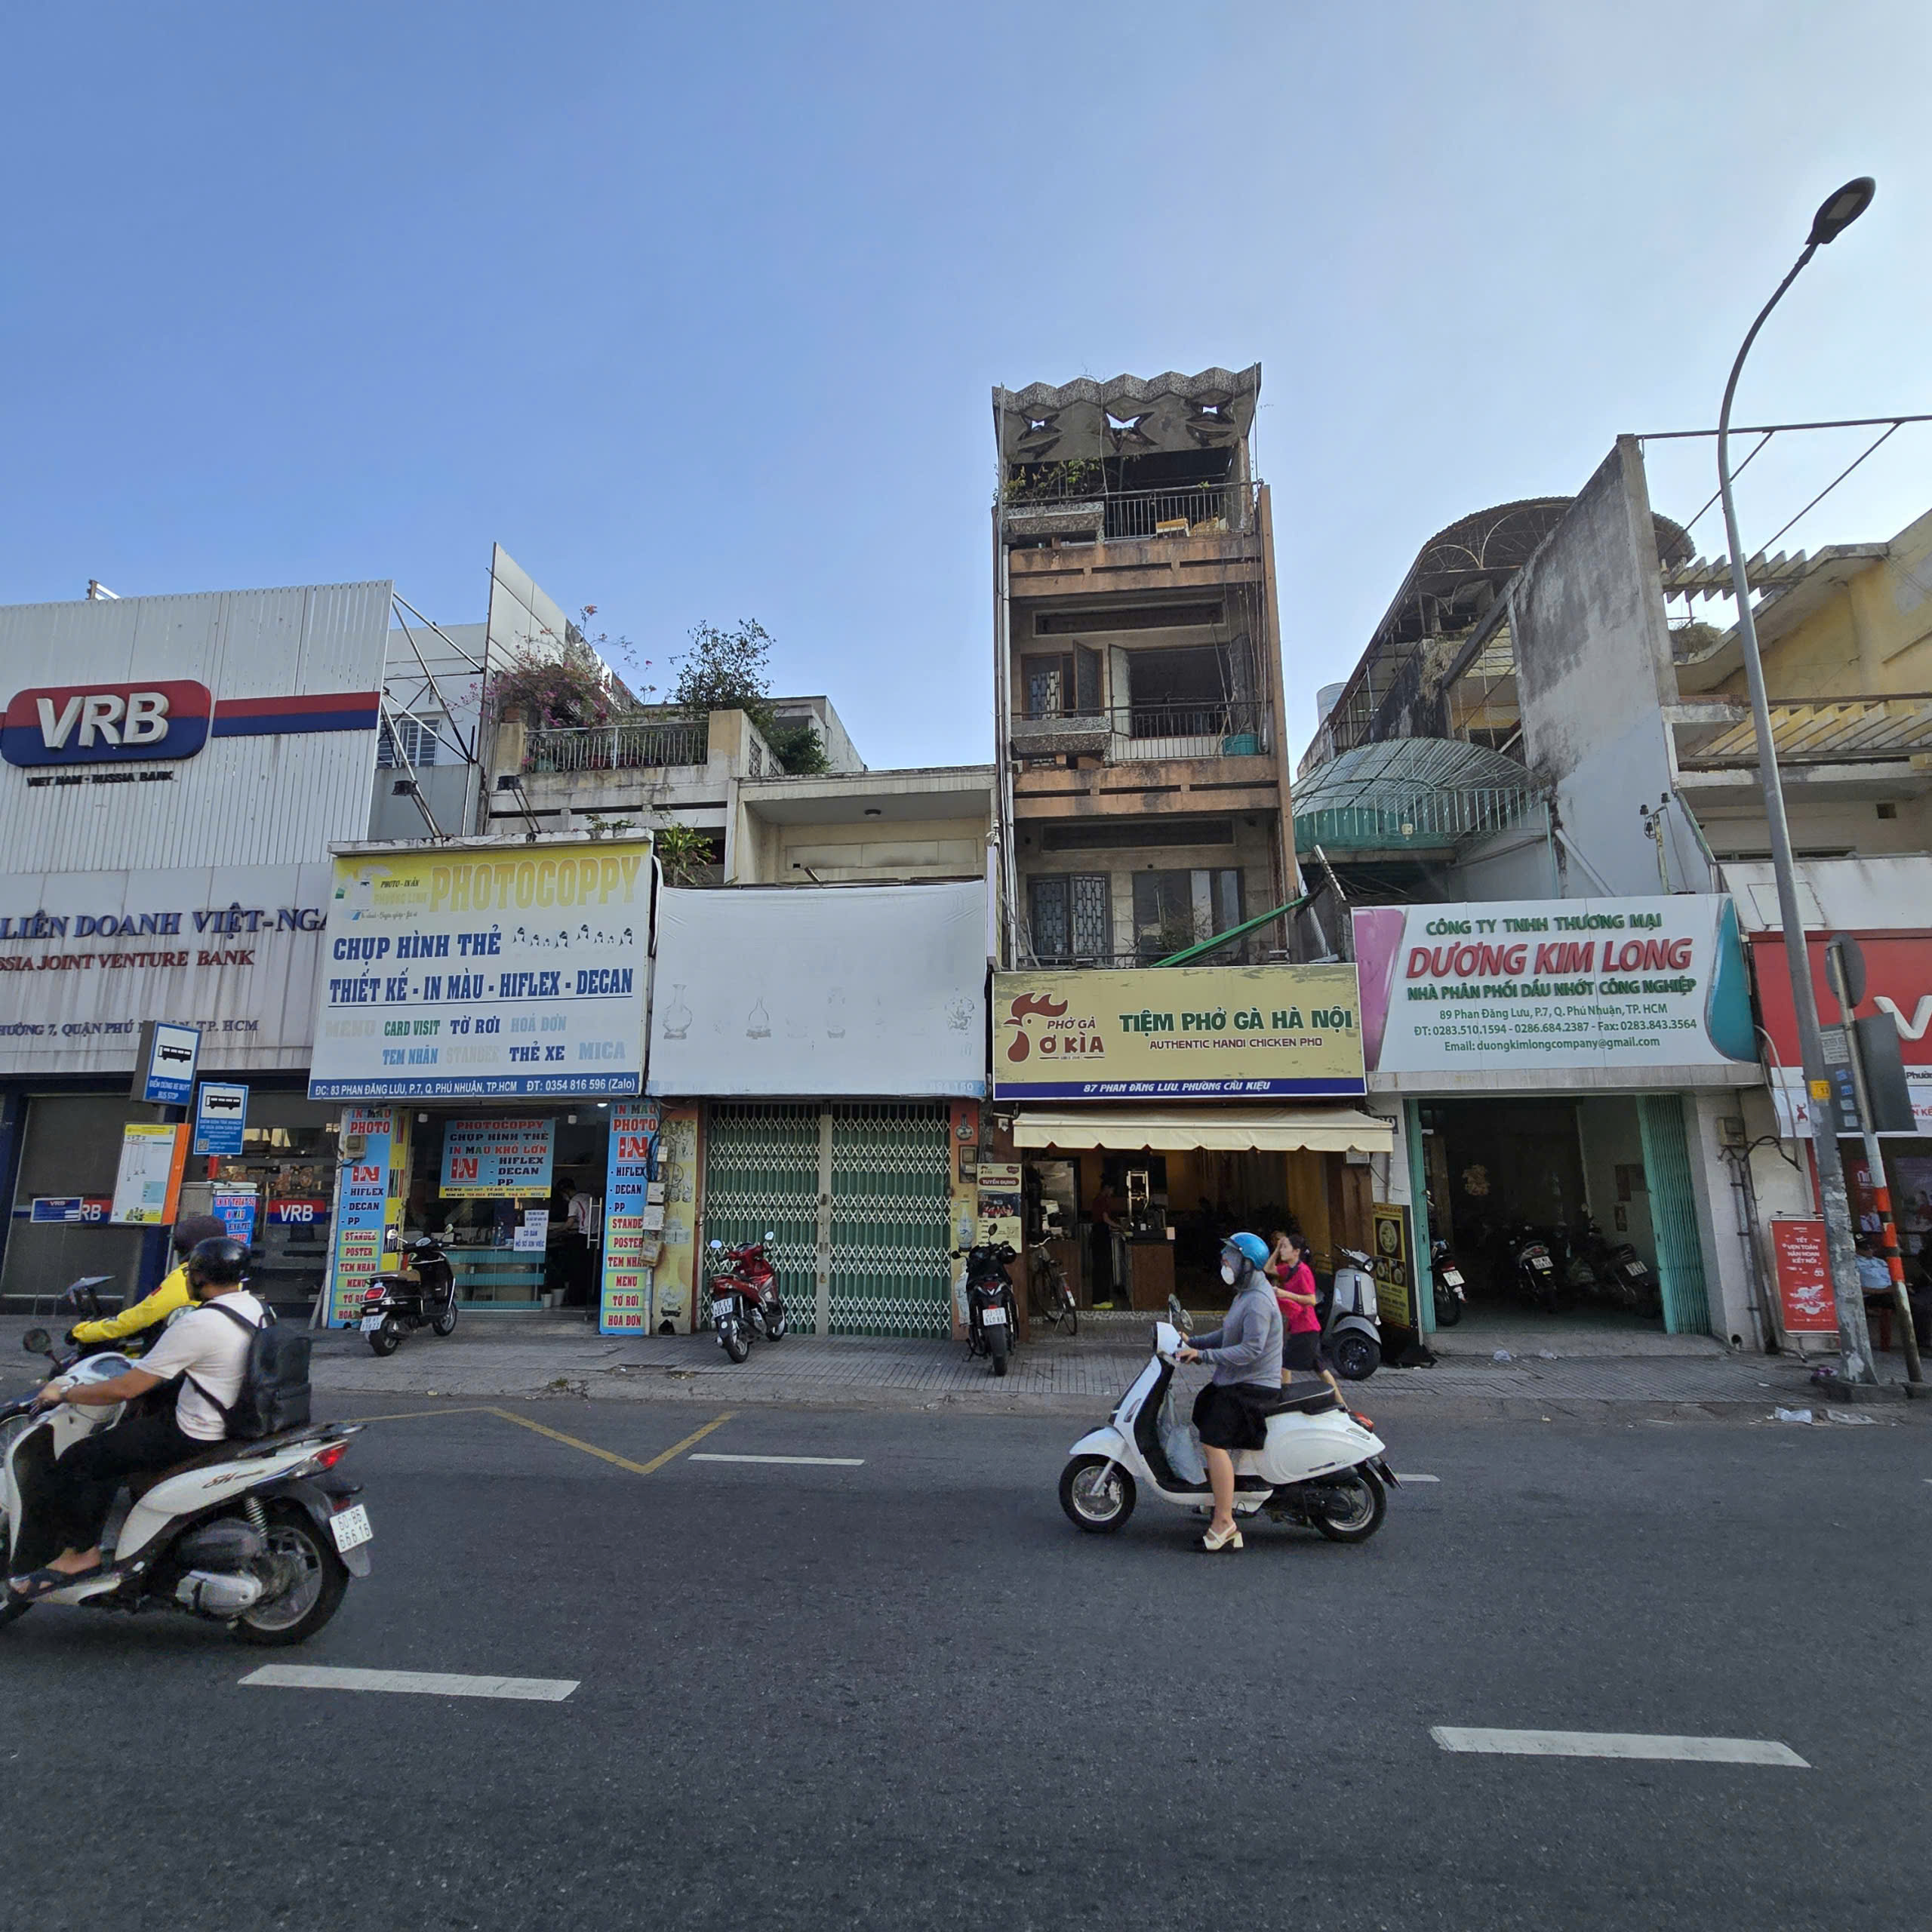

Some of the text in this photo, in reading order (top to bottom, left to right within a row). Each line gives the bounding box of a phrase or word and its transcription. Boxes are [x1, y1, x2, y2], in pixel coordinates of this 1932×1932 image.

[36, 692, 169, 749] VRB
[92, 773, 135, 784] RUSSIA
[139, 771, 174, 782] BANK
[429, 857, 641, 912] PHOTOCOPPY
[73, 912, 183, 937] DOANH
[1426, 913, 1663, 936] CÔNG TY TNHH THƯƠNG MẠI
[333, 924, 501, 966] CHỤP HÌNH THẺ
[38, 954, 96, 971] JOINT
[98, 951, 189, 969] VENTURE
[197, 950, 255, 967] BANK
[1406, 937, 1694, 978] DƯƠNG KIM LONG
[330, 967, 633, 1003] THIẾT KẾ IN MÀU HIFLEX DECAN
[1407, 983, 1438, 1001] NHÀ
[1441, 982, 1481, 1000] PHÂN
[1483, 980, 1518, 998] PHỐI
[1554, 979, 1595, 996] NHỚT
[1598, 977, 1641, 995] CÔNG
[1642, 976, 1697, 996] NGHIỆP
[1119, 1005, 1352, 1037] TIỆM PHỞ GÀ HÀ NỘI
[1439, 1010, 1452, 1020] 89
[1454, 1009, 1479, 1020] Phan
[1481, 1008, 1509, 1022] Đăng
[1511, 1008, 1534, 1020] Lưu,
[1554, 1006, 1565, 1017] Q.
[1567, 1005, 1586, 1017] Phú
[1588, 1005, 1625, 1017] Nhuận,
[1626, 1004, 1641, 1014] TP.
[1643, 1004, 1668, 1014] HCM
[62, 1022, 101, 1037] QUẬN
[104, 1020, 132, 1034] PHÚ
[222, 1020, 260, 1032] HCM
[384, 1020, 411, 1037] CARD
[414, 1020, 441, 1036] VISIT
[451, 1015, 471, 1035] TỜ
[475, 1015, 500, 1034] RƠI
[1414, 1019, 1697, 1036] ĐT: 0283.510.1594 0286.684.2387 Fax: 0283.843.3564
[1039, 1031, 1104, 1054] Ơ KÌA
[1149, 1039, 1210, 1050] AUTHENTIC
[1249, 1038, 1297, 1048] CHICKEN
[1300, 1037, 1322, 1047] PHO
[1444, 1037, 1660, 1054] Email: duongkimlongcompany@gmail.com
[383, 1049, 405, 1066] TEM
[509, 1041, 540, 1062] THẺ
[544, 1045, 565, 1061] XE
[578, 1041, 626, 1060] MICA
[315, 1086, 329, 1095] ĐC:
[331, 1085, 340, 1095] 83
[341, 1084, 363, 1095] PHAN
[365, 1082, 387, 1094] ĐĂNG
[425, 1083, 433, 1094] Q.
[435, 1081, 452, 1094] PHÚ
[454, 1080, 484, 1094] NHUẬN,
[487, 1081, 517, 1092] TP.HCM
[527, 1081, 543, 1091] ĐT:
[545, 1079, 568, 1091] 0354
[570, 1079, 586, 1091] 816
[589, 1078, 606, 1091] 596
[608, 1078, 635, 1091] (Zalo)
[1083, 1084, 1097, 1093] 87
[1100, 1083, 1127, 1092] PHAN
[1129, 1082, 1155, 1092] ĐĂNG
[1182, 1081, 1221, 1091] PHƯỜNG
[1246, 1081, 1271, 1092] KIỆU
[614, 1104, 626, 1115] IN
[350, 1121, 390, 1134] PHOTO
[456, 1121, 543, 1130] PHOTOCOPPY
[614, 1118, 657, 1131] PHOTO
[450, 1133, 483, 1142] CHỤP
[616, 1167, 646, 1177] HIFLEX
[350, 1188, 384, 1196] HIFLEX
[615, 1184, 641, 1195] DECAN
[279, 1204, 313, 1221] VRB
[349, 1202, 380, 1211] DECAN
[614, 1202, 625, 1212] PP
[612, 1218, 642, 1229] STANDE
[346, 1247, 372, 1257] POSTER
[340, 1263, 355, 1272] TEM
[608, 1257, 624, 1267] TEM
[616, 1276, 638, 1287] MENU
